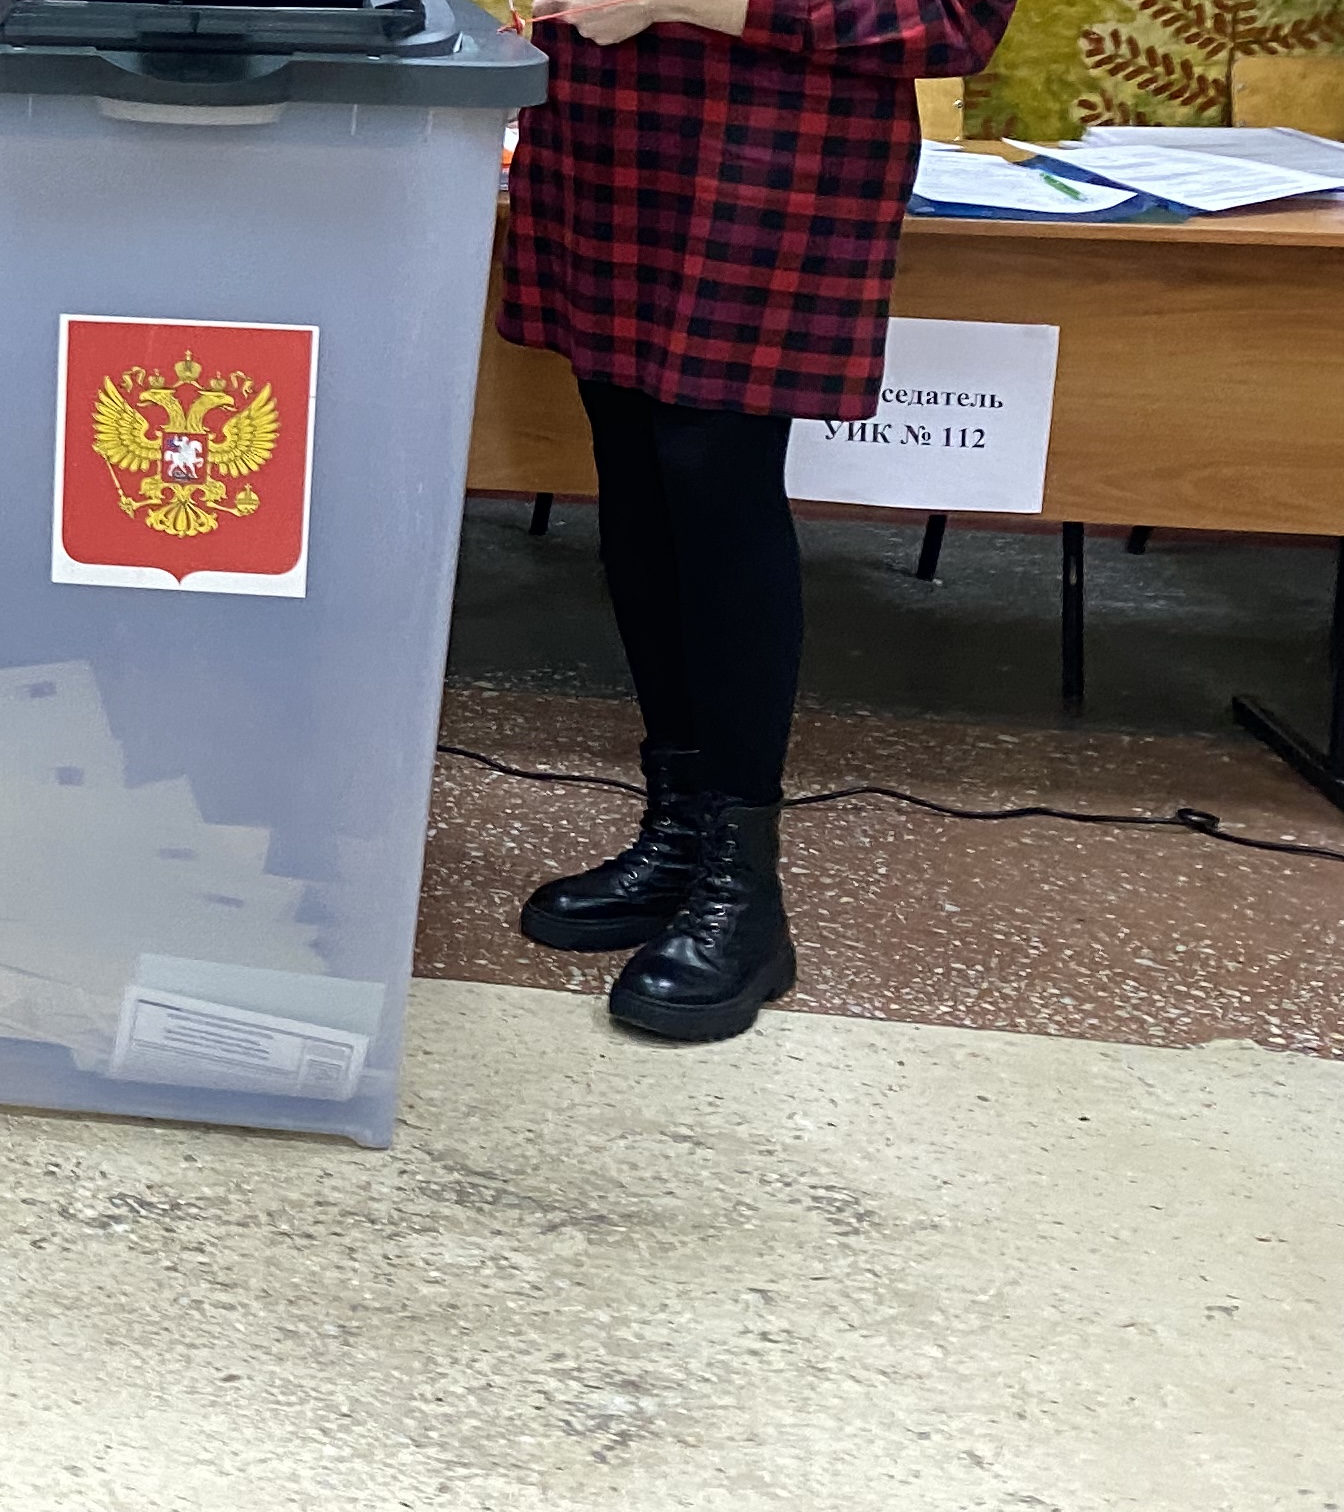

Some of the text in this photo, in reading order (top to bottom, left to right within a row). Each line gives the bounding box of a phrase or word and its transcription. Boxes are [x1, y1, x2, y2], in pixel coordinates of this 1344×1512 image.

[881, 386, 1005, 409] седатель
[824, 419, 987, 449] УИК № 112
